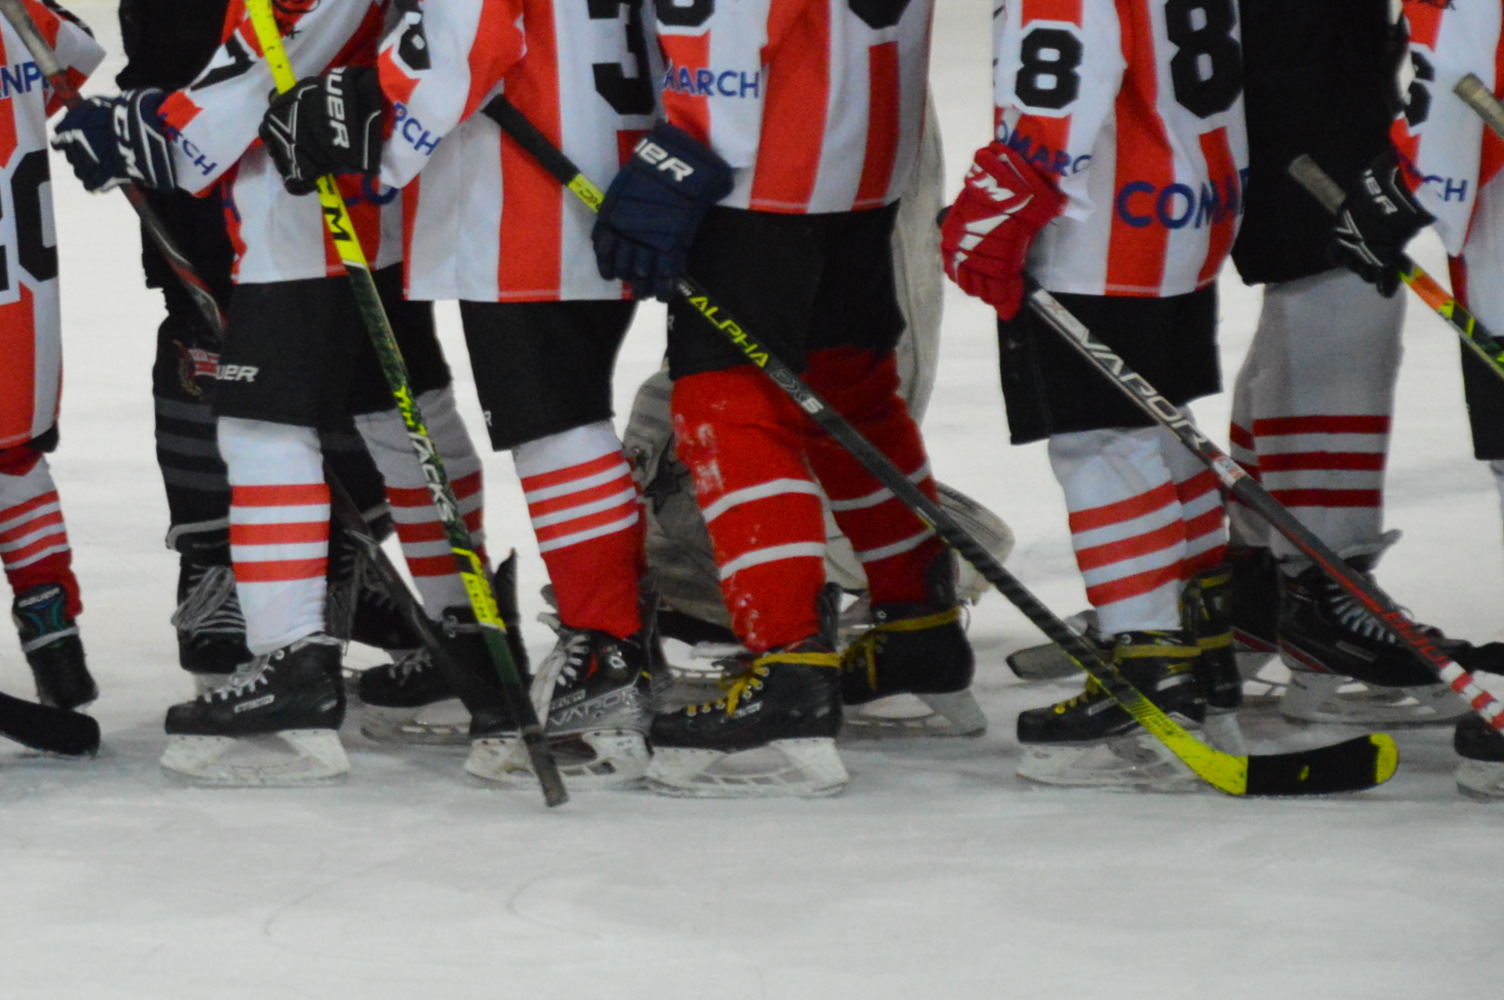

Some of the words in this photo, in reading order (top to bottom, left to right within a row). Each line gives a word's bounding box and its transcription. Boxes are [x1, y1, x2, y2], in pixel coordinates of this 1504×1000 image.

[1015, 27, 1084, 110] 8
[689, 295, 770, 369] ALPHA
[1082, 342, 1210, 452] VAPOR
